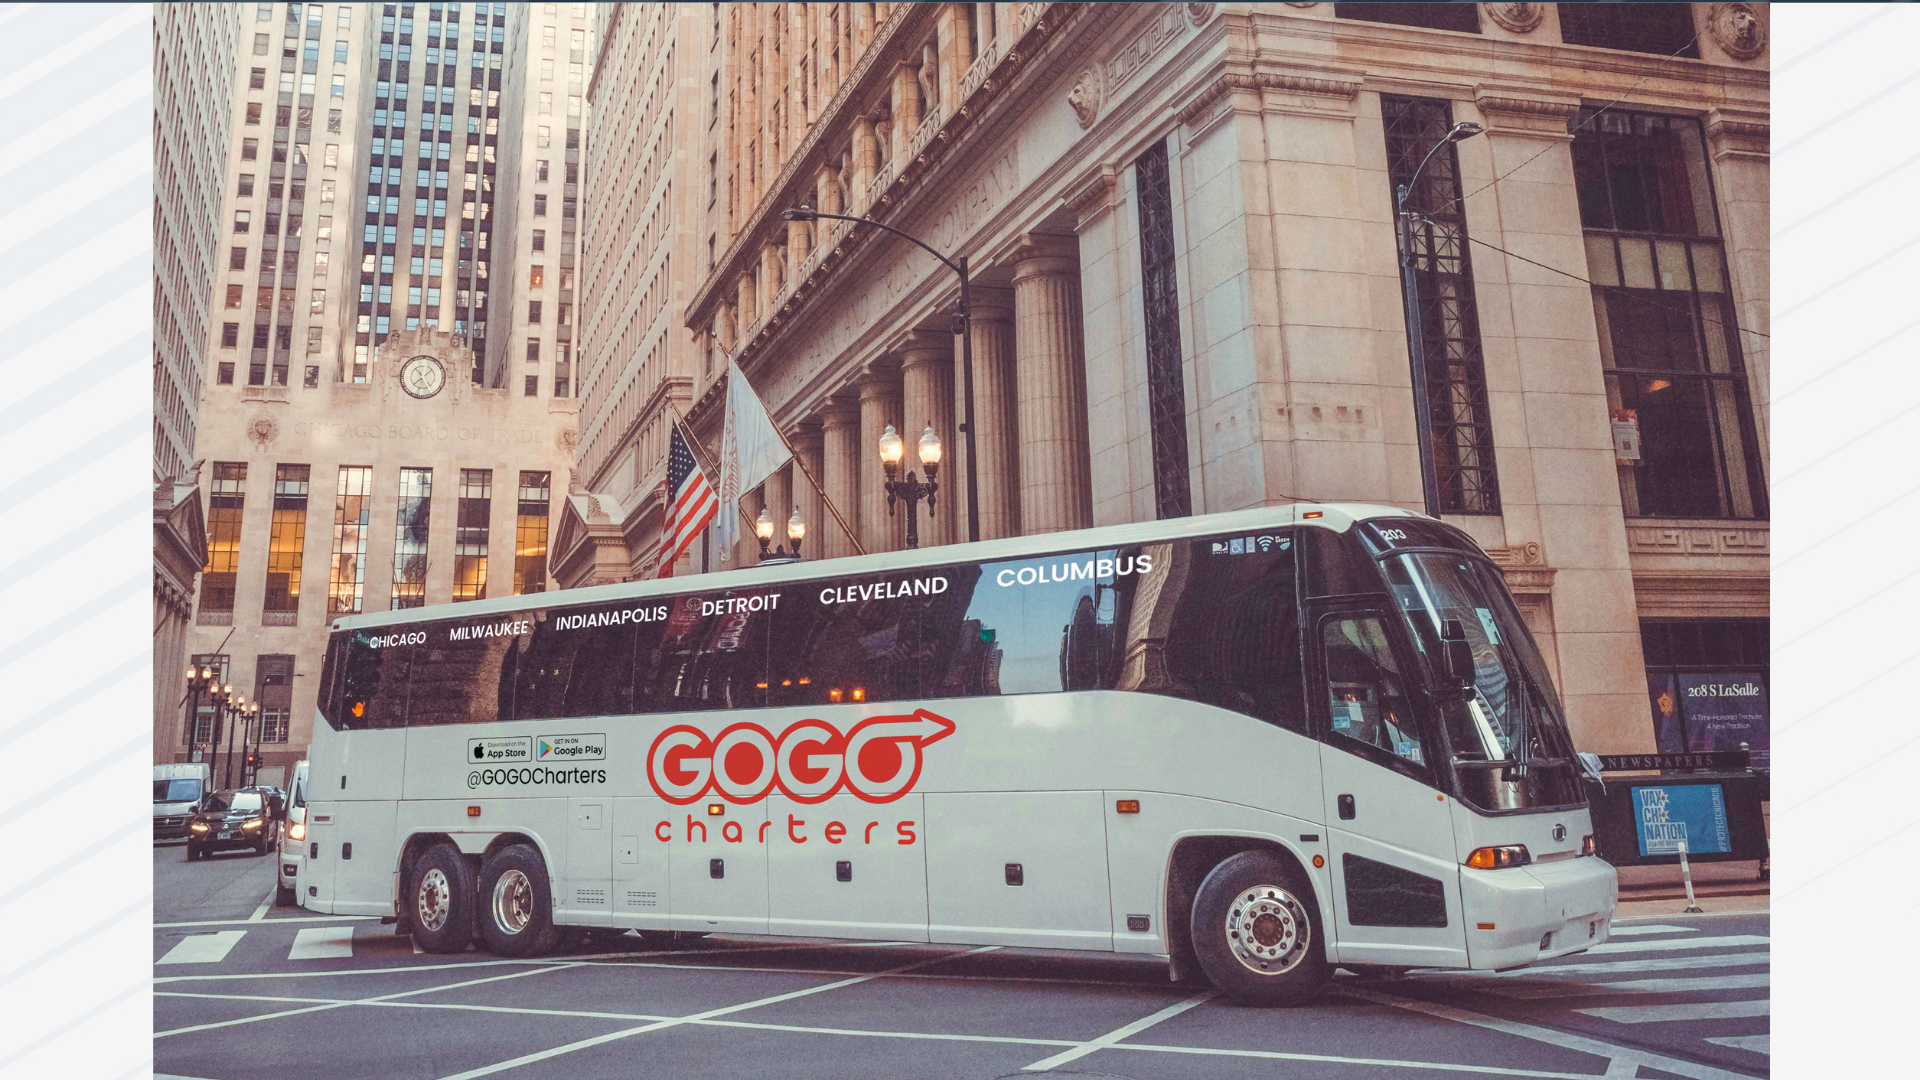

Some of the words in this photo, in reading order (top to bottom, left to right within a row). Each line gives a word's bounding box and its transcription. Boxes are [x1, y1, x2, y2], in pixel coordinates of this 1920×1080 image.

[930, 139, 1018, 261] COMPANY
[294, 422, 381, 438] CHICAGO
[388, 425, 449, 440] BOARD
[457, 427, 480, 440] OF
[488, 428, 543, 444] TRADE
[1380, 529, 1406, 541] 203
[370, 631, 426, 648] CHICAGO
[450, 620, 528, 641] MILWAUKEE
[555, 605, 668, 631] INDIANAPOLIS
[702, 594, 780, 616] DETROIT
[820, 576, 948, 605] CLEVELAND
[997, 555, 1152, 587] COLUMBUS
[1688, 684, 1707, 697] 208
[1709, 684, 1717, 697] S
[1718, 683, 1759, 697] LaSalle
[487, 749, 504, 759] App
[505, 747, 526, 757] Store
[554, 745, 583, 756] Google
[585, 745, 603, 756] Play
[647, 708, 956, 805] GOGO
[1608, 755, 1714, 769] NEWSPAPERS
[467, 766, 606, 789] @GOGOCharters
[1641, 790, 1663, 807] VAX
[655, 813, 916, 845] charters
[1645, 823, 1686, 840] NATION
